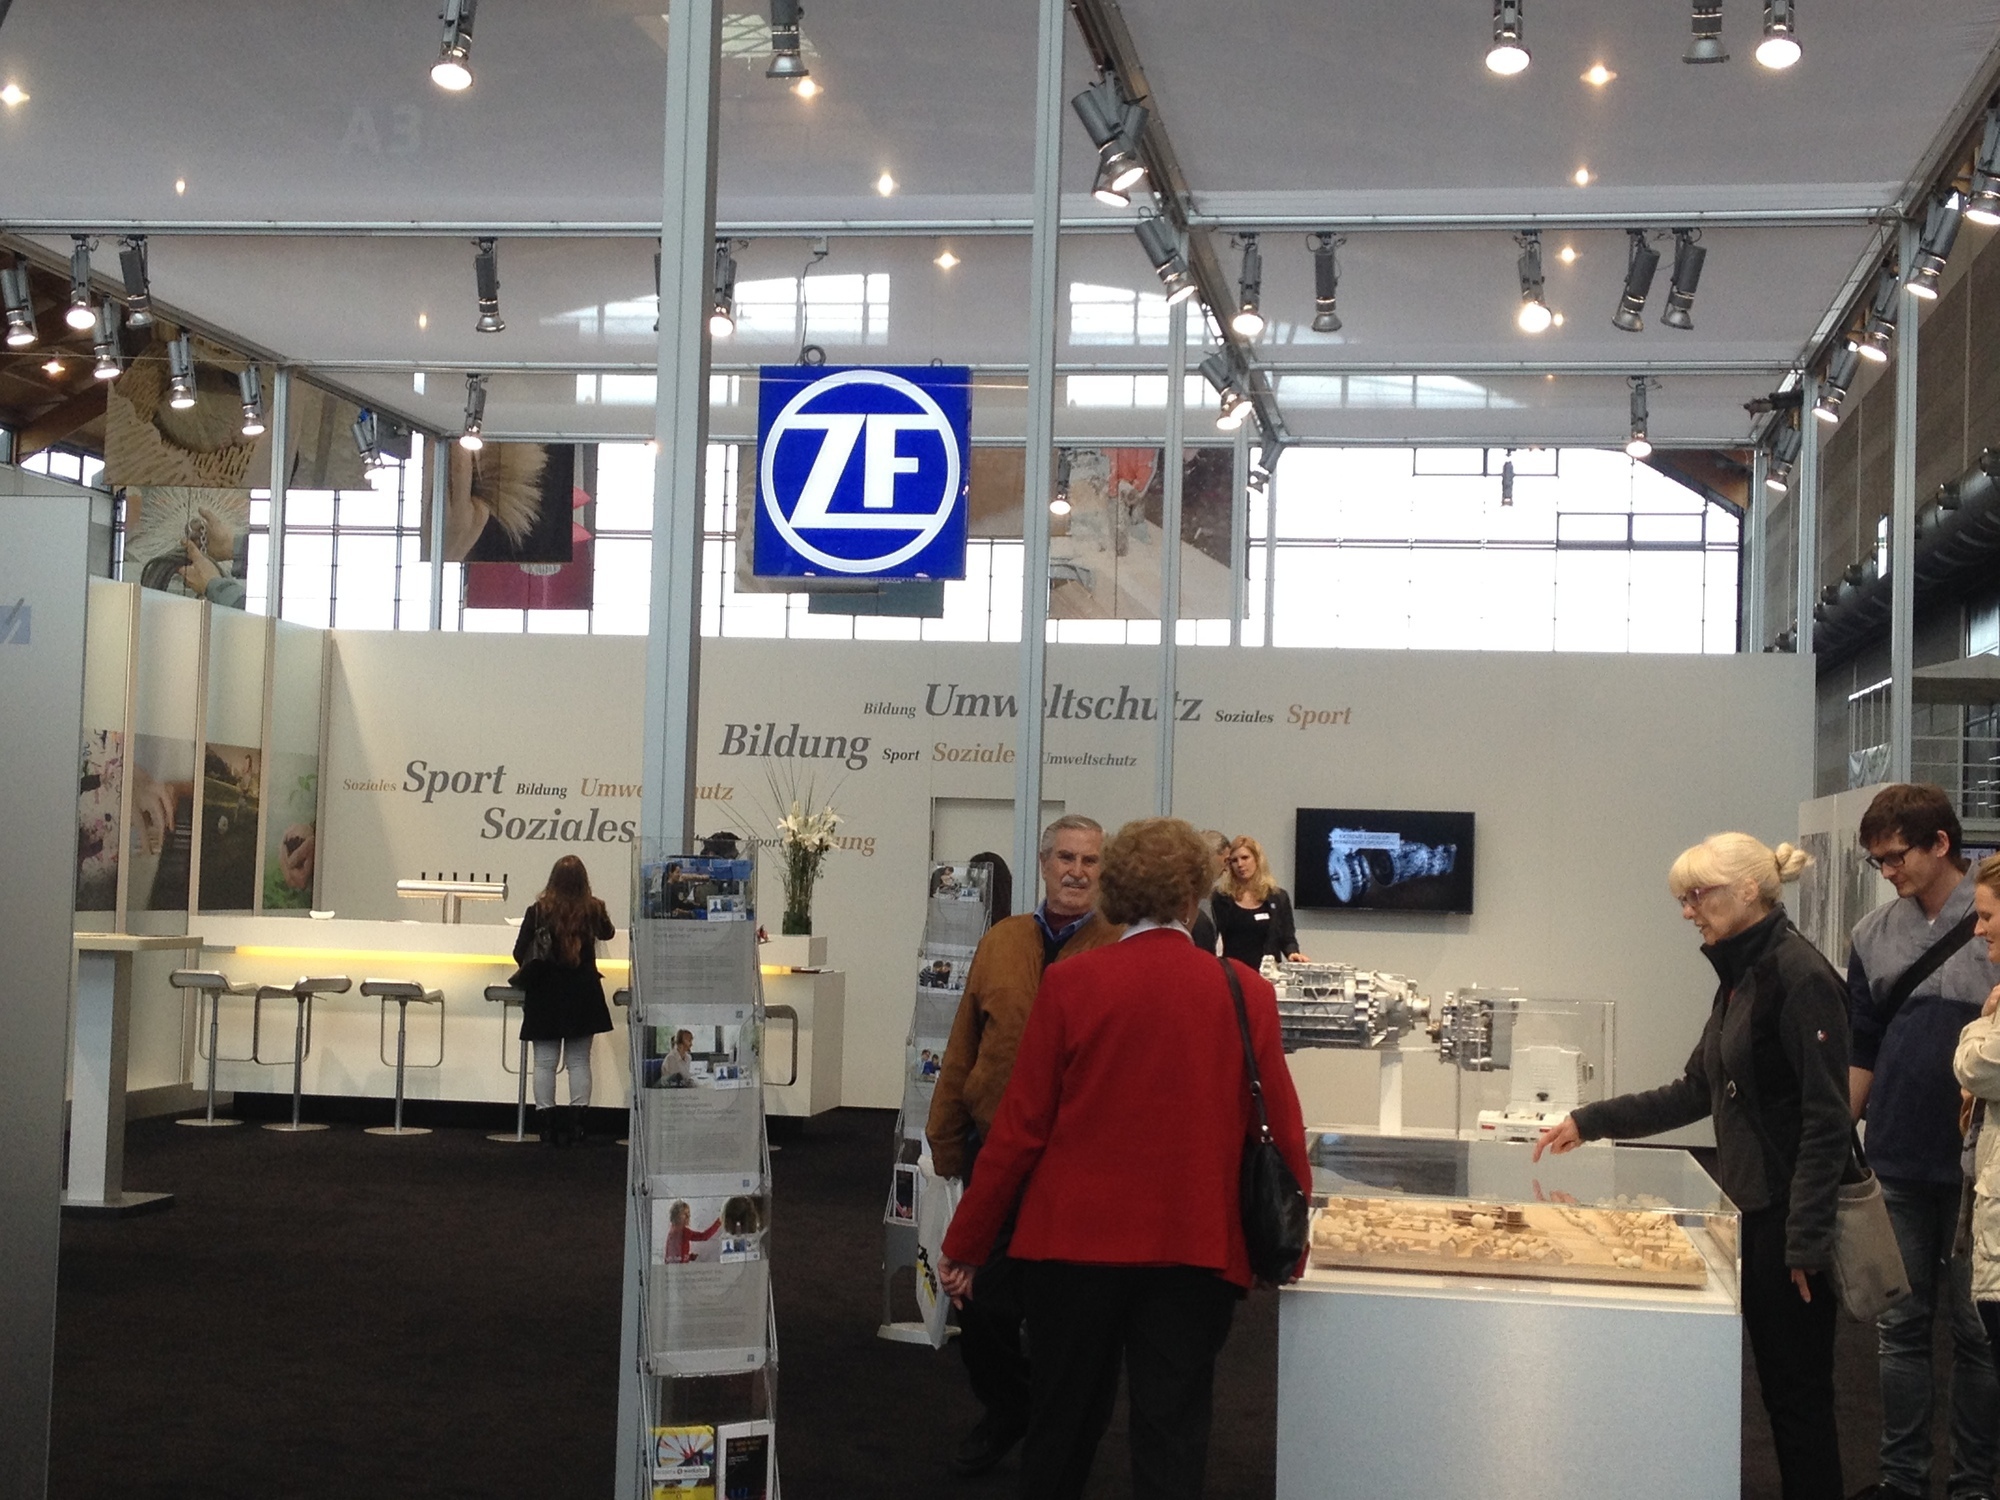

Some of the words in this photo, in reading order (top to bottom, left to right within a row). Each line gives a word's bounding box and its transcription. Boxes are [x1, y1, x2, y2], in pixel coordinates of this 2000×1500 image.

[775, 408, 948, 533] ZF
[863, 702, 916, 719] Bildung
[925, 683, 1203, 721] Umwltschuz
[1214, 710, 1274, 723] Soziales
[1287, 704, 1352, 730] Sport
[719, 723, 871, 770] Bildung
[882, 748, 920, 763] Sport
[932, 742, 1016, 763] Soziale
[342, 779, 397, 791] Soziales
[402, 760, 507, 803] Sport
[516, 783, 568, 799] Bildung
[480, 807, 637, 843] Soziales
